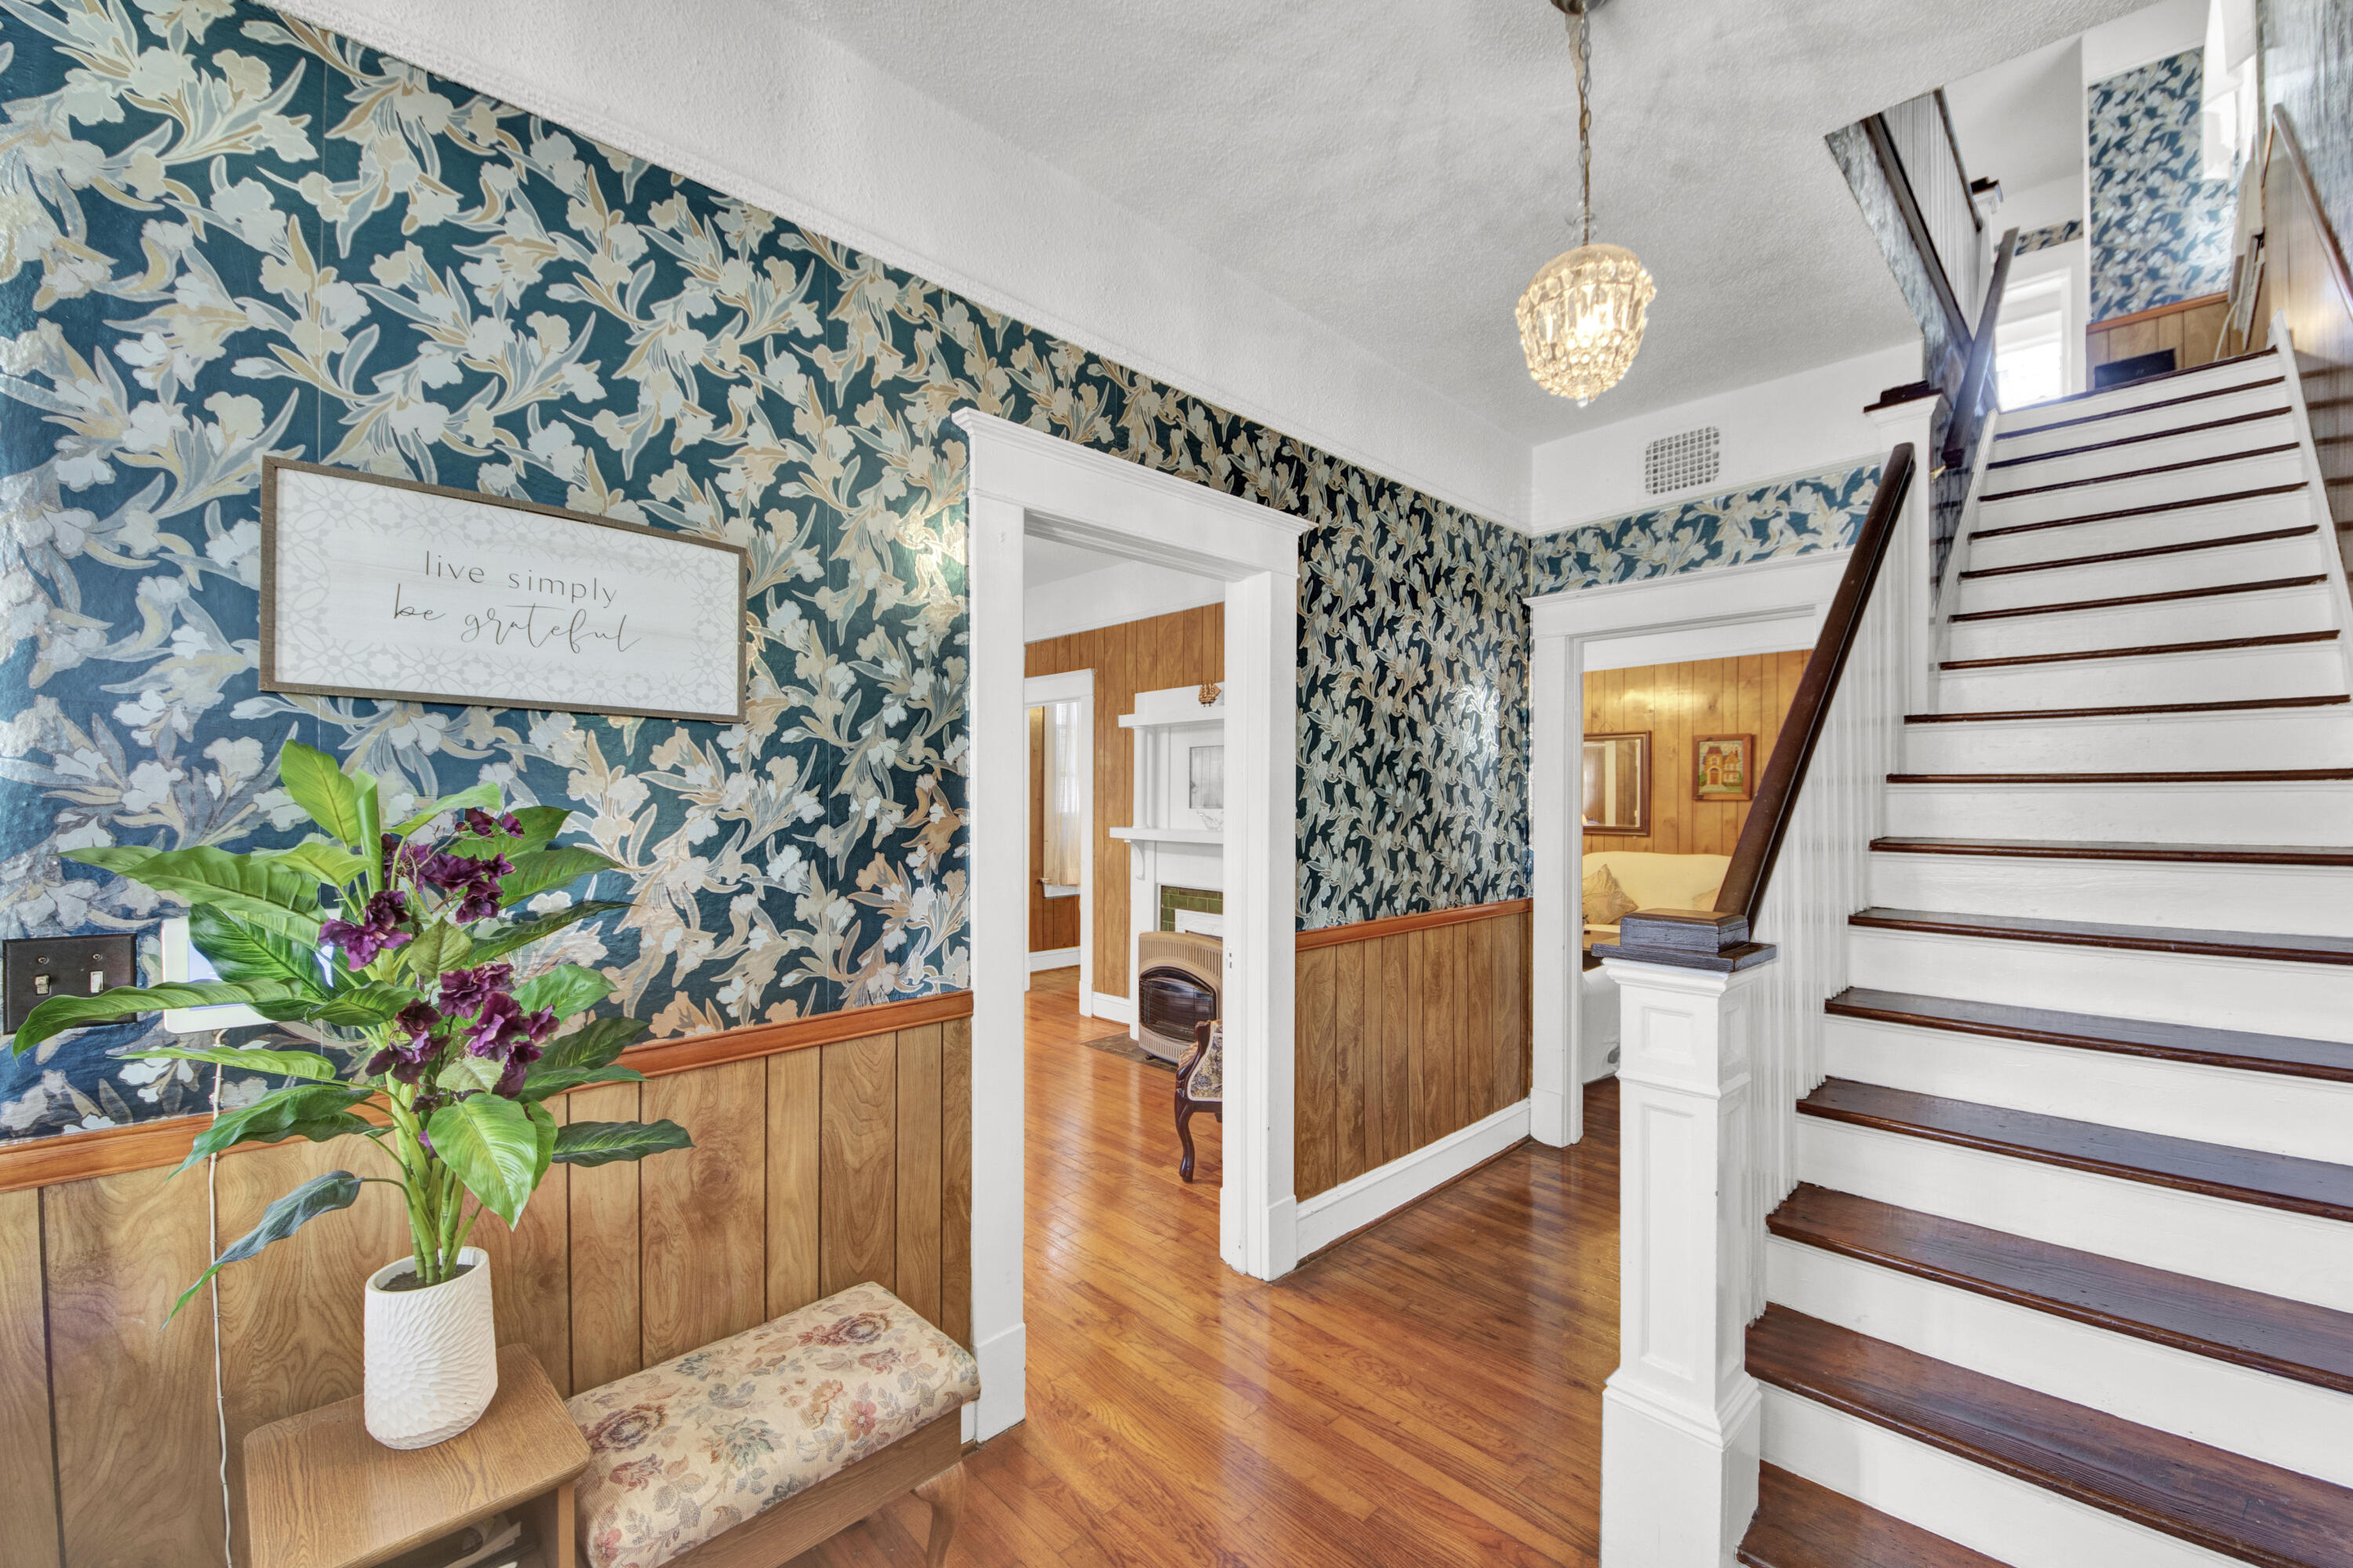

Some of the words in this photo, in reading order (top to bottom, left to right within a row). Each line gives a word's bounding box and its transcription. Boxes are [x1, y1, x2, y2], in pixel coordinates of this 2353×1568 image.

[426, 550, 486, 584] live
[508, 569, 617, 609] simply
[393, 583, 446, 620] be
[460, 602, 642, 654] grateful
